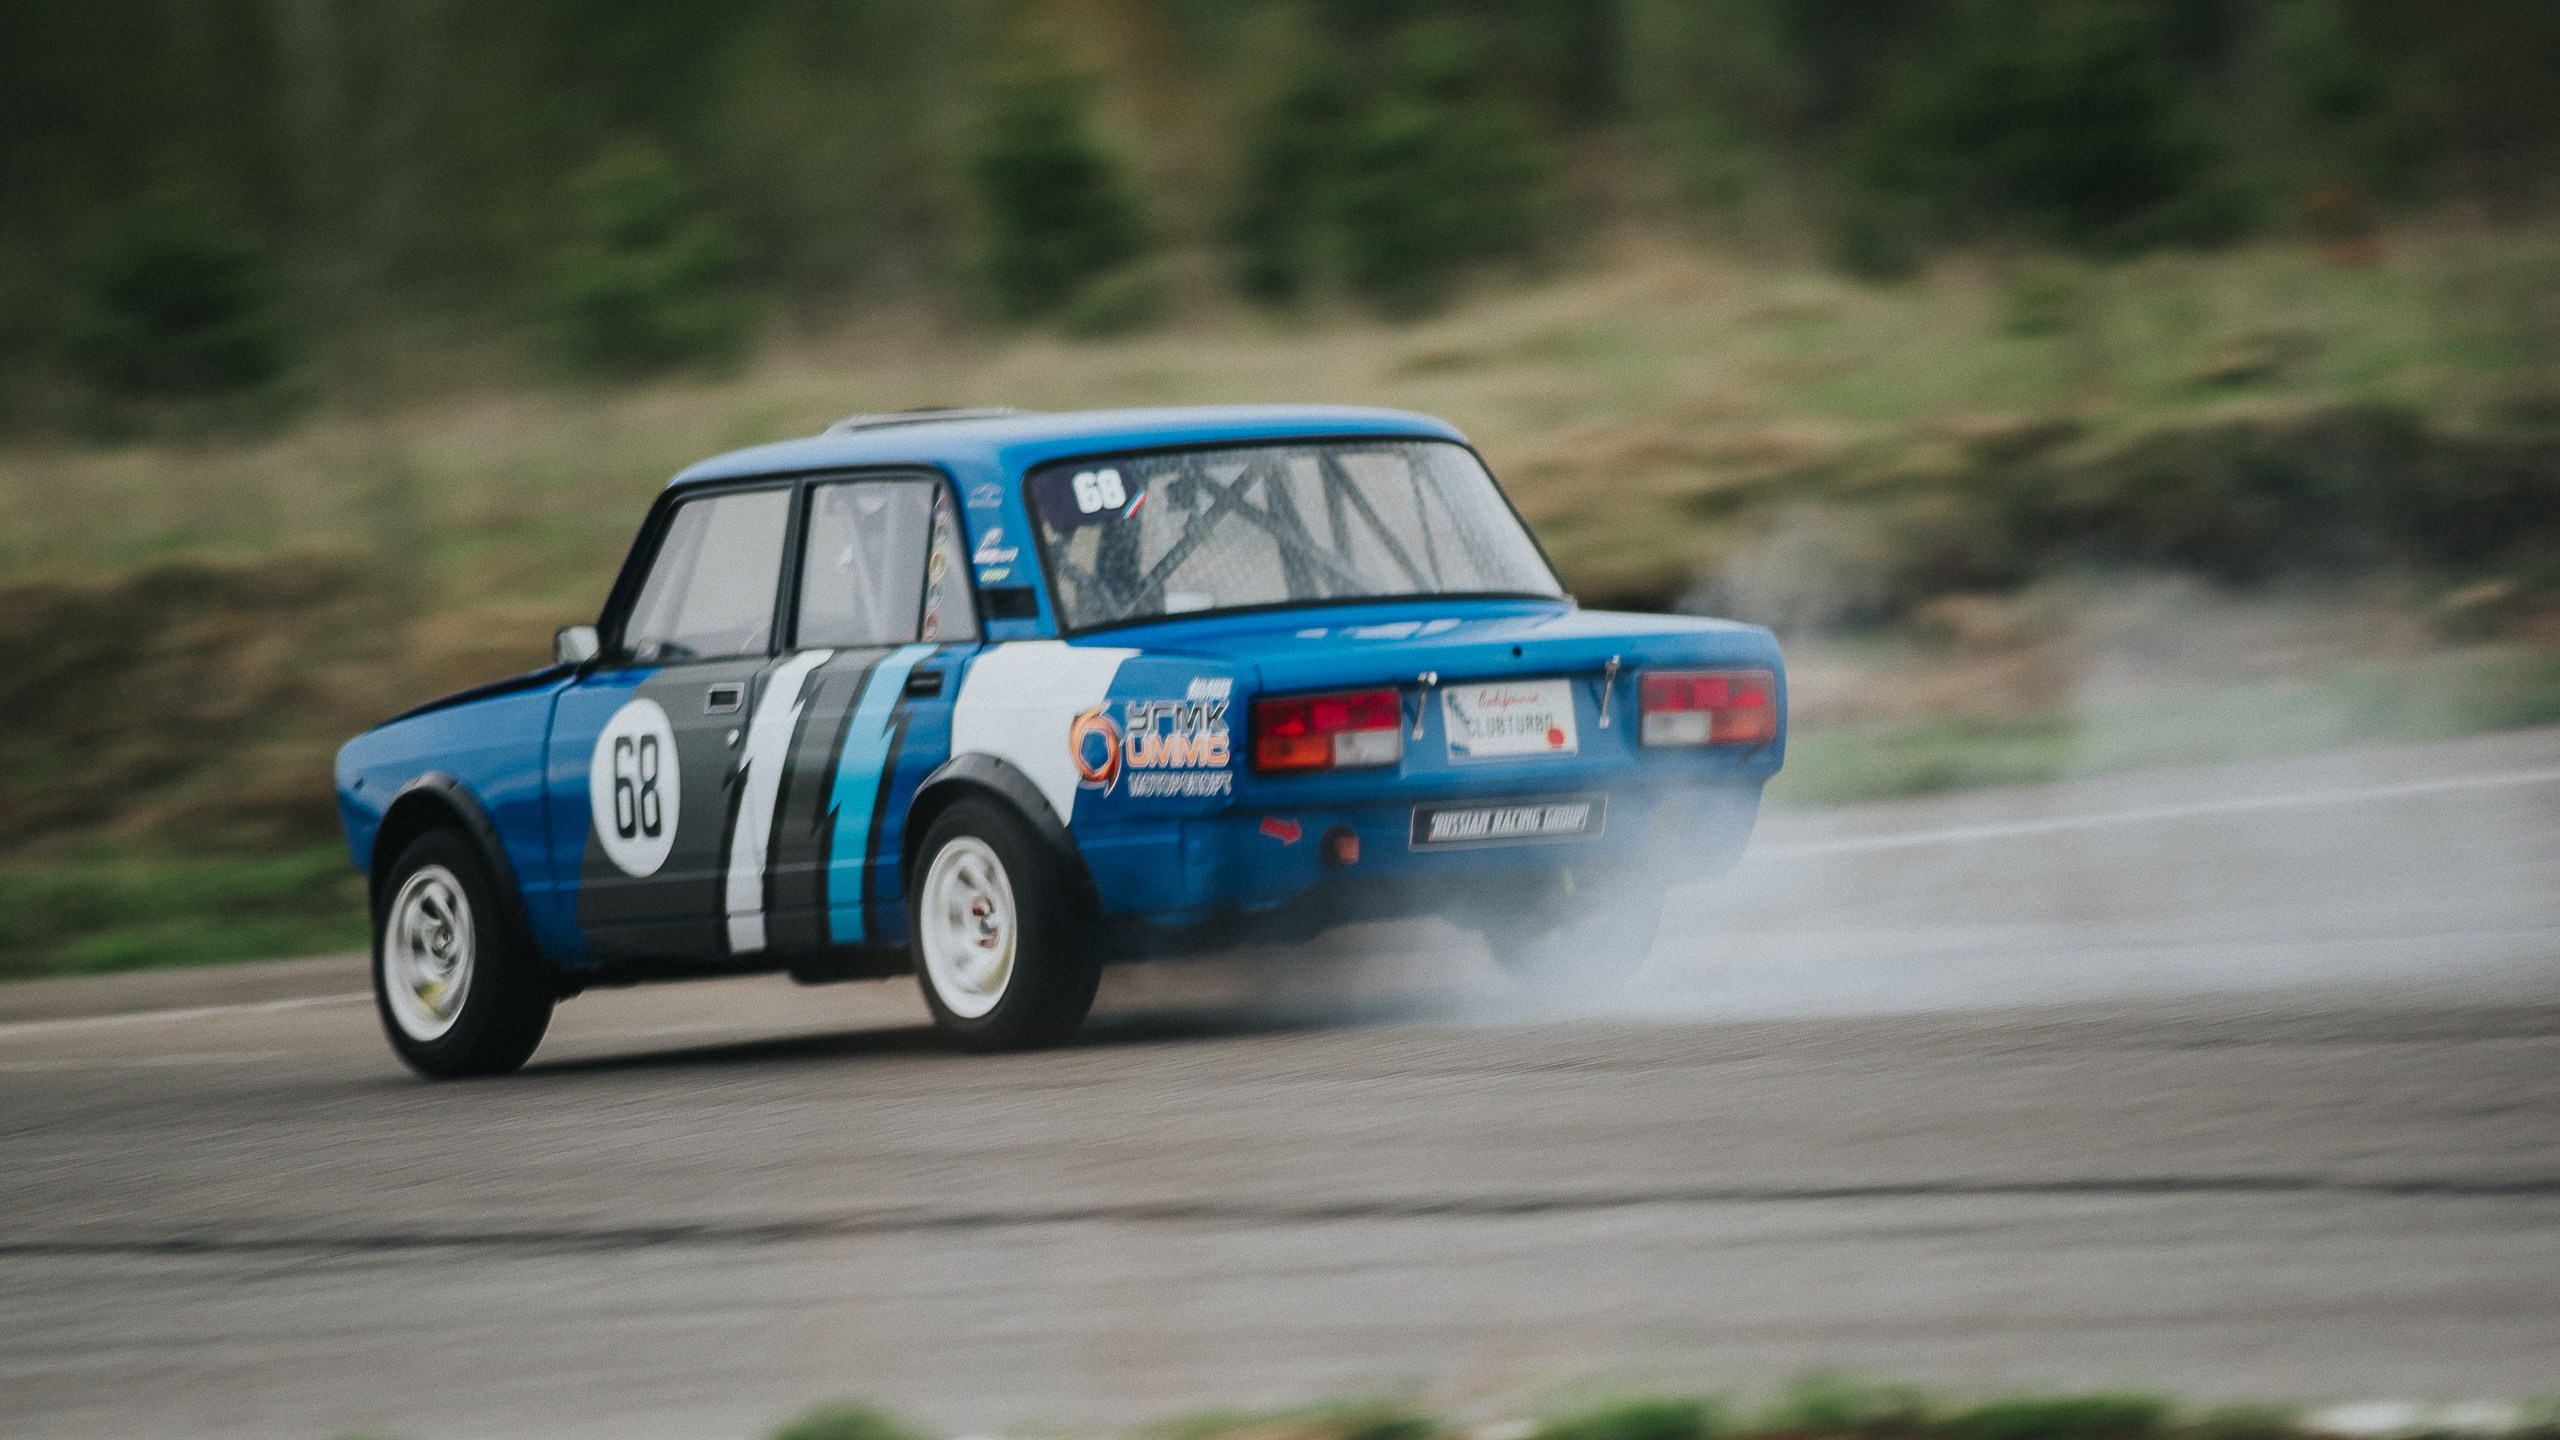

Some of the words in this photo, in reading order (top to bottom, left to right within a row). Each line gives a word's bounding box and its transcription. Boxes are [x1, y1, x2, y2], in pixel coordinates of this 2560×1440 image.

[1073, 469, 1126, 514] 68
[1126, 701, 1230, 734] УГМК
[1126, 734, 1230, 768] UMMC
[615, 734, 661, 838] 68
